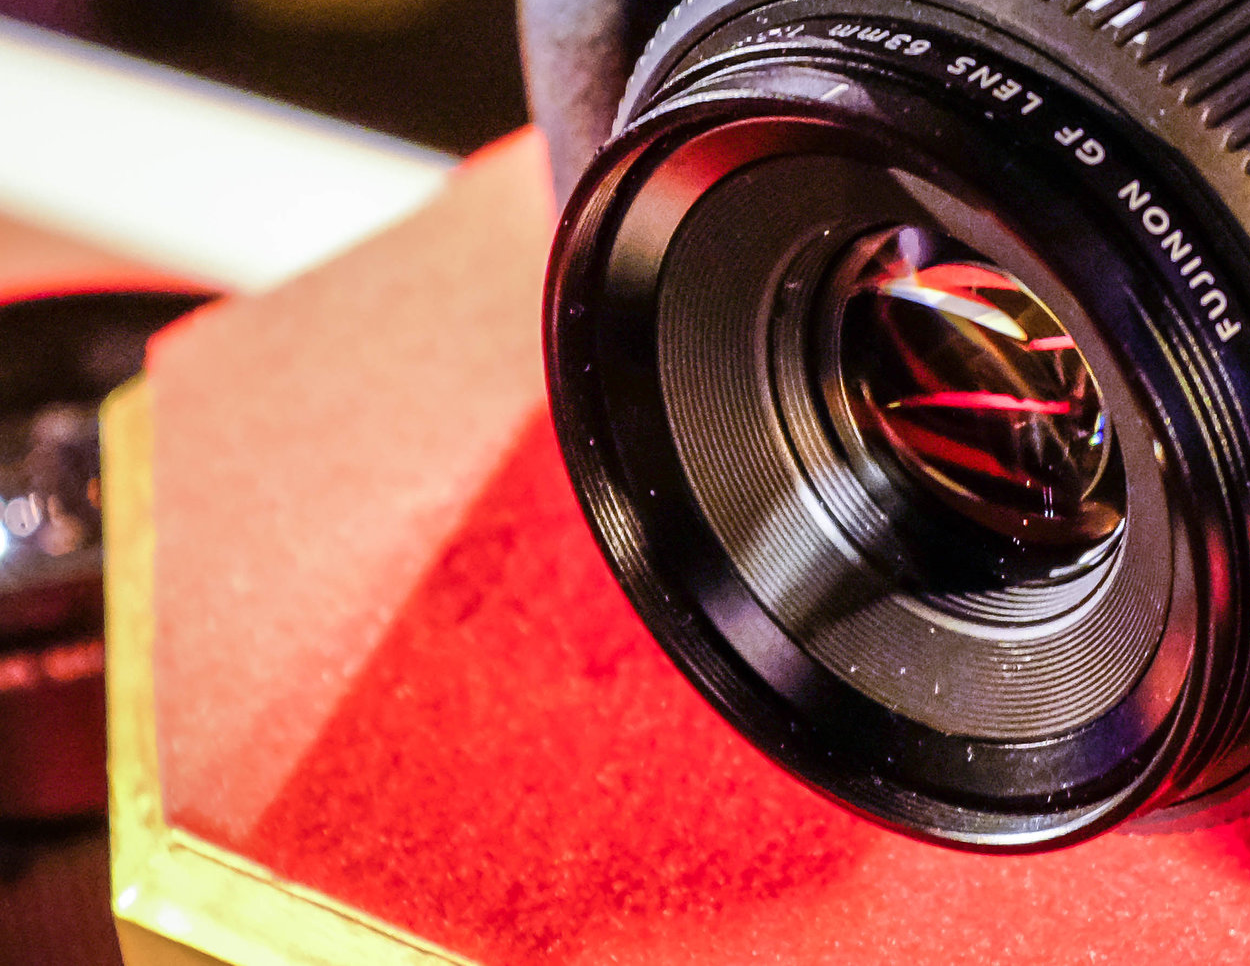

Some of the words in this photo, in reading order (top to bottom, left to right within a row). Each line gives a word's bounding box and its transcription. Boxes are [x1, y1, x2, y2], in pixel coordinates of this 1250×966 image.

[828, 23, 932, 57] 63mm
[946, 54, 1044, 115] LENS
[1054, 125, 1106, 166] GF
[1117, 179, 1242, 343] FUJINON
